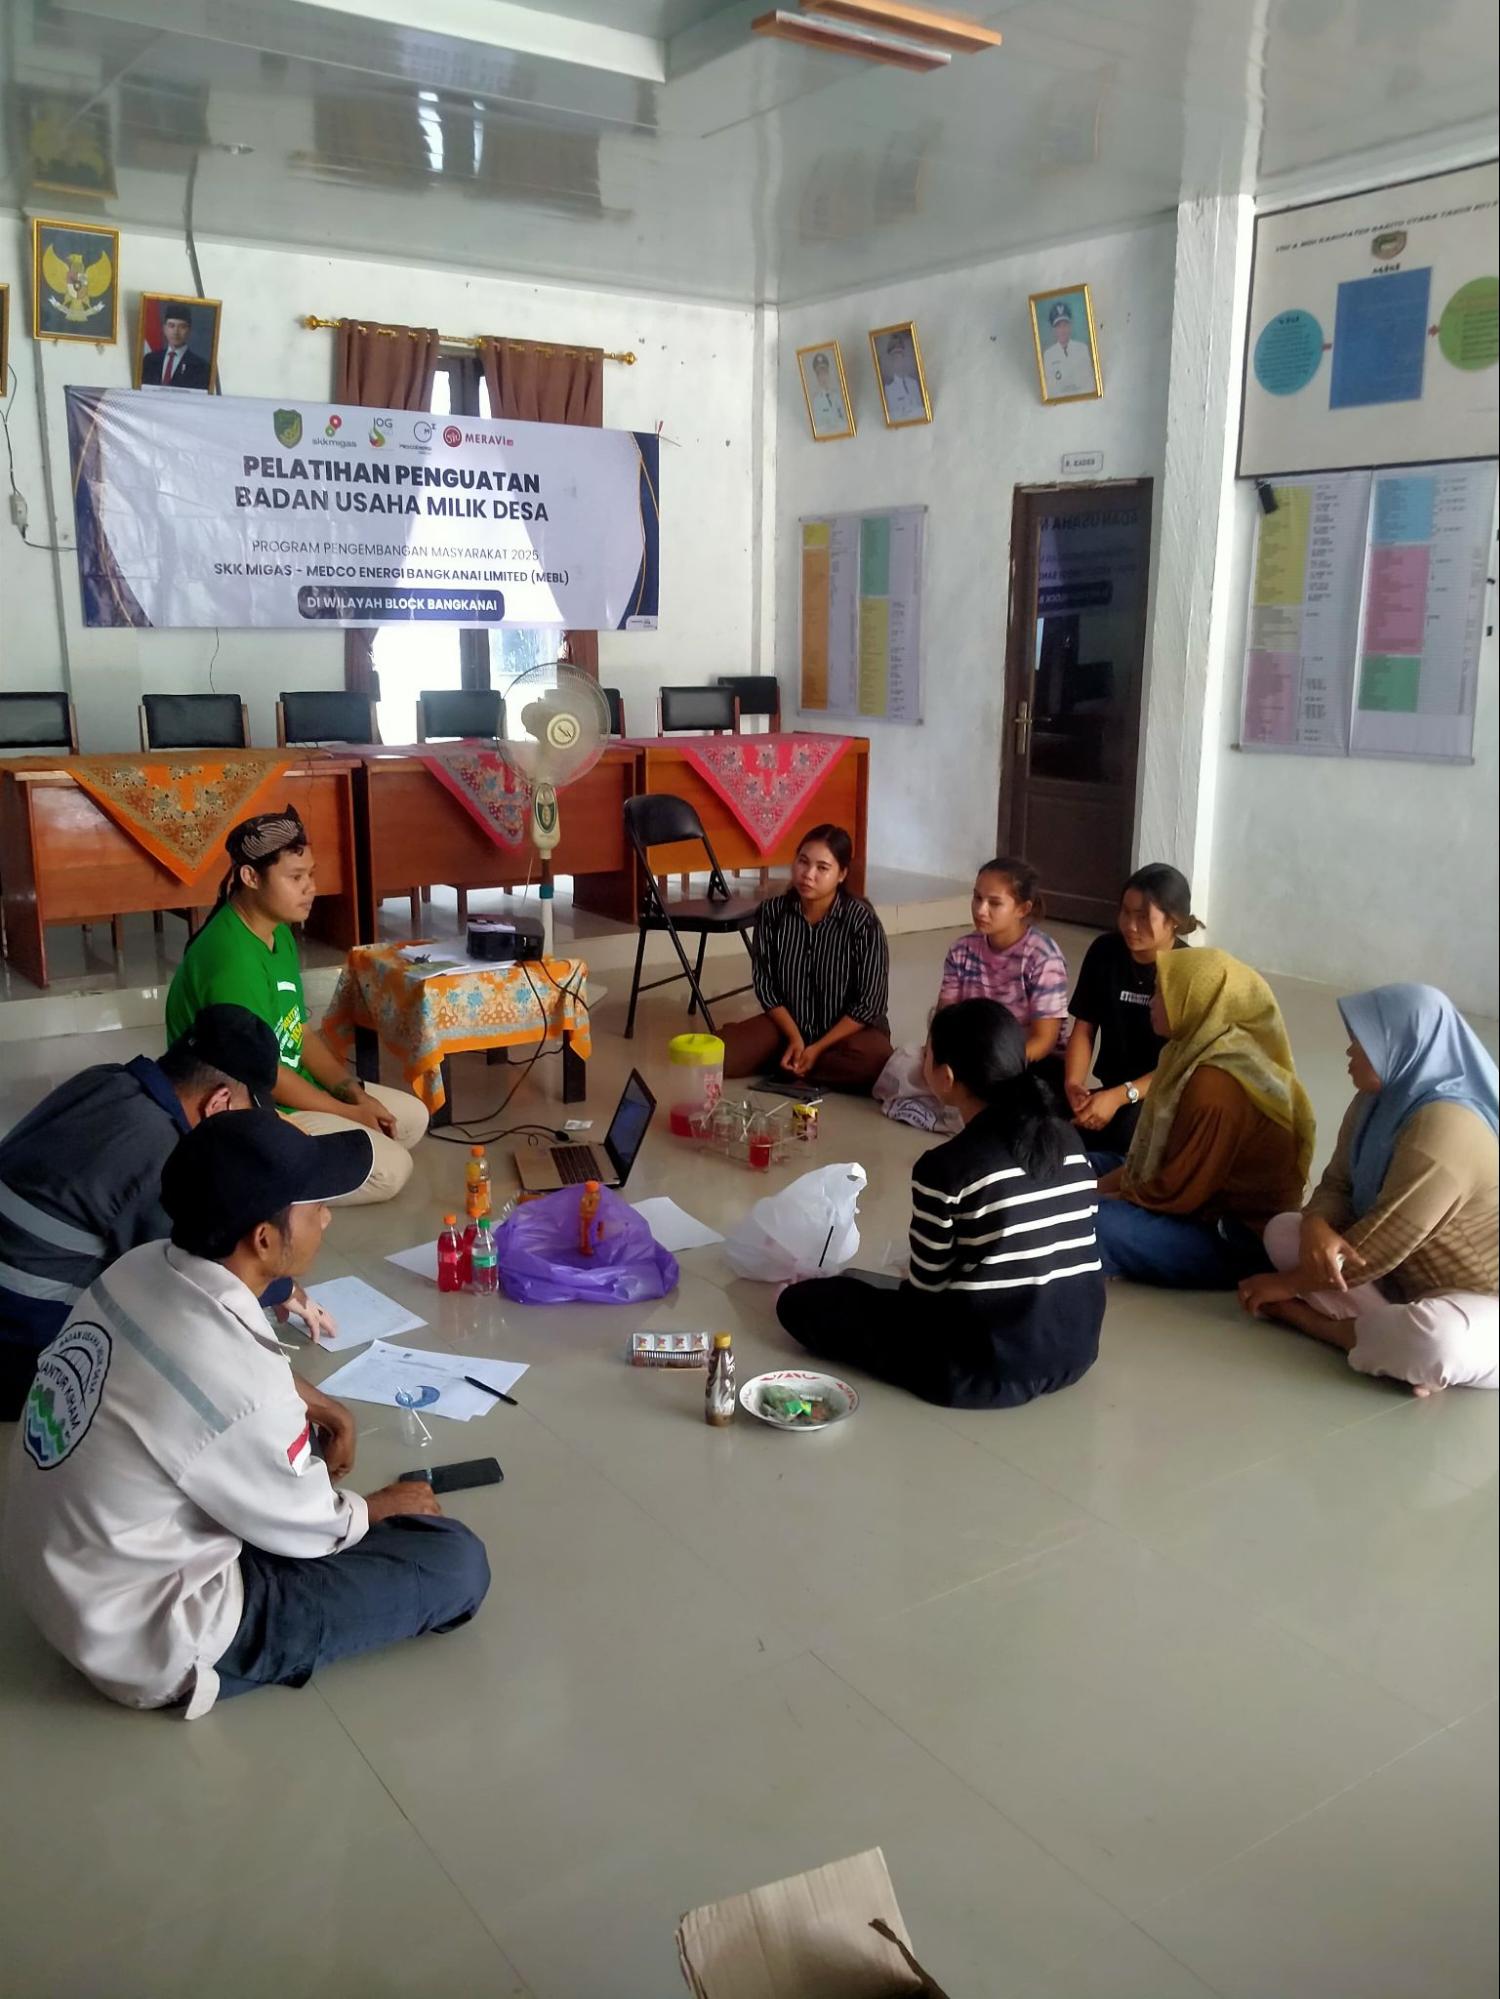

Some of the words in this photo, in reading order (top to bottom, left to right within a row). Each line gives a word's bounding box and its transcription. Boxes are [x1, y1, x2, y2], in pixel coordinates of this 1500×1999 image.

[243, 455, 390, 484] PELATIHAN
[395, 464, 540, 493] PENGUATAN
[234, 486, 329, 511] BADAN
[335, 491, 421, 515] USAHA
[427, 496, 487, 519] MILIK
[493, 500, 549, 521] DESA
[252, 540, 320, 554] PROGRAM
[323, 542, 428, 557] PENGEMBANGAN
[431, 547, 508, 560] MASYARAKAT
[511, 549, 539, 561] 2025
[214, 563, 242, 575] SKK
[246, 563, 292, 576] MIGAS
[306, 565, 356, 578] MEDCO
[359, 566, 404, 579] ENERGI
[407, 568, 481, 581] BANGKANAI
[484, 571, 528, 582] LIMITED
[531, 571, 569, 586] (MEBL)
[307, 597, 320, 608] DI
[323, 597, 383, 609] WILAYAH
[385, 597, 425, 610] BLOCK
[427, 598, 497, 611] BANGKANAI
